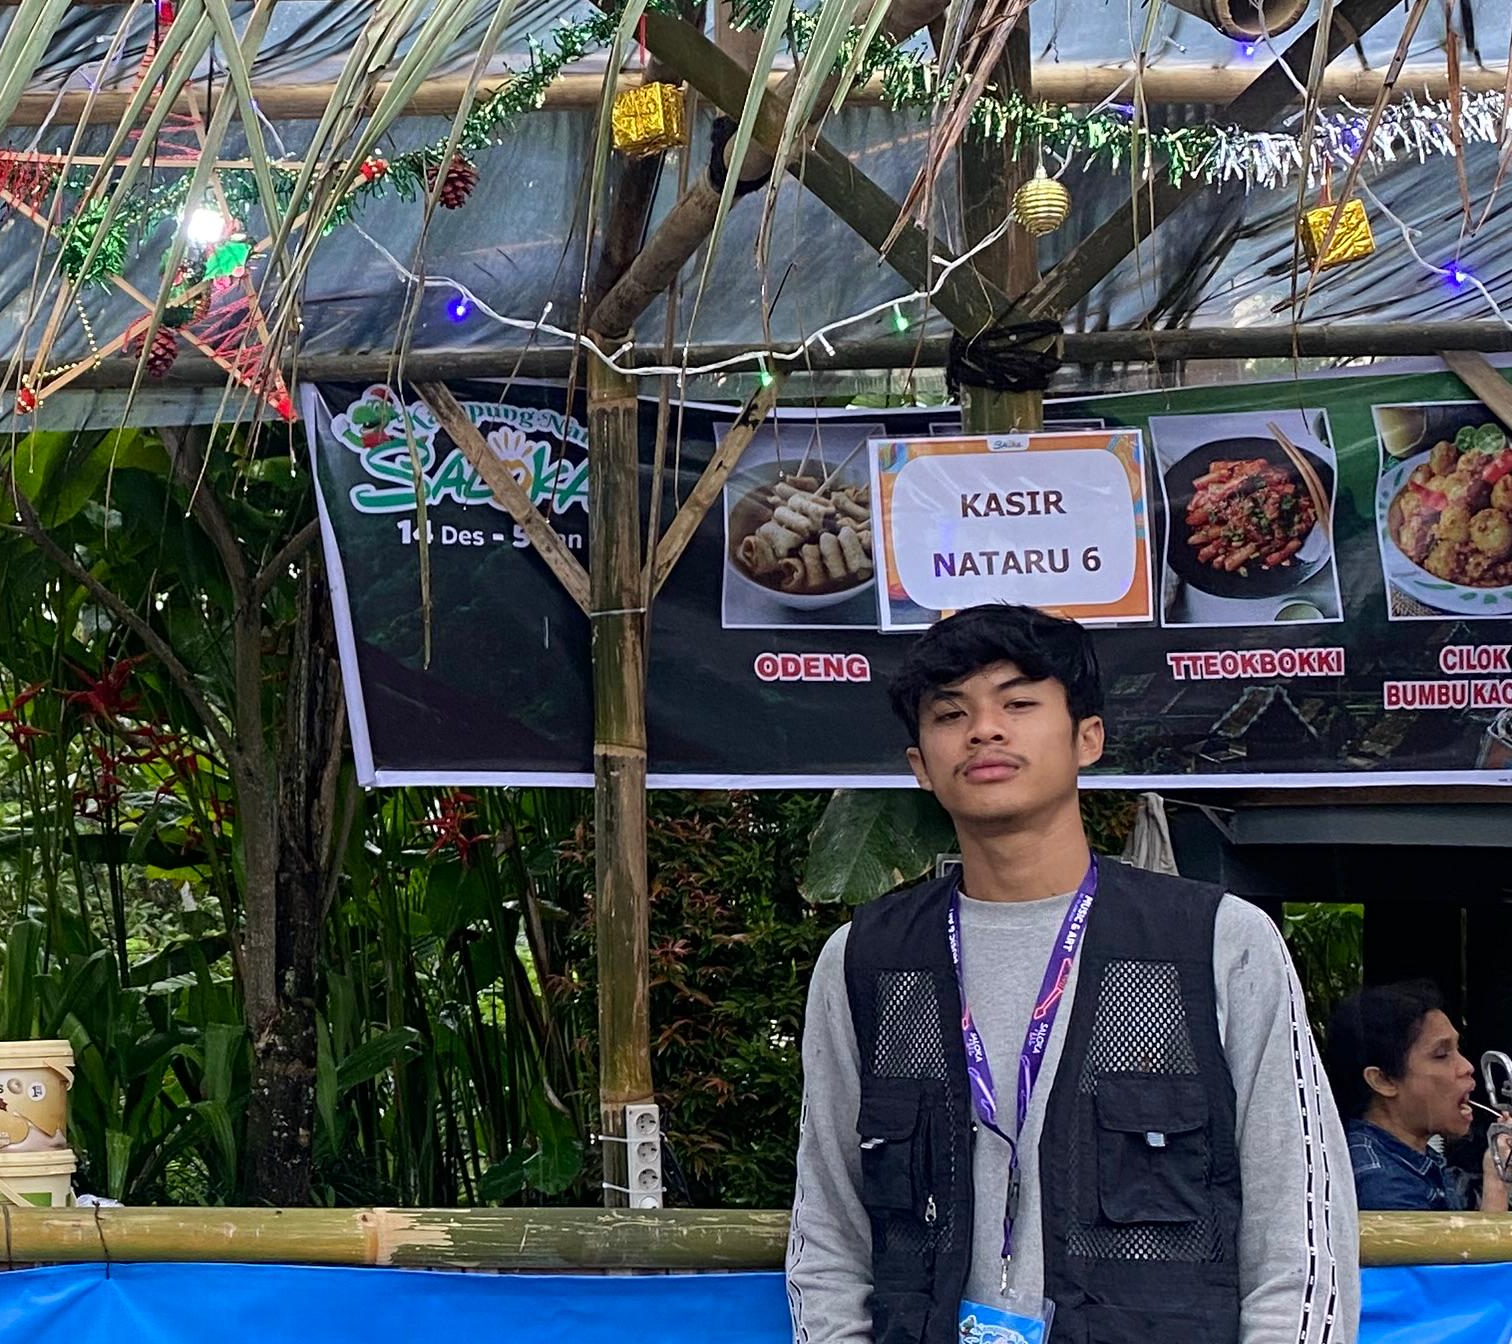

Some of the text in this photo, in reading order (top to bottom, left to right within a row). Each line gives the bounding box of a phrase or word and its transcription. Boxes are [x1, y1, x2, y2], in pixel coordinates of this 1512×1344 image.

[961, 490, 1066, 518] KASIR
[441, 526, 485, 546] Des
[933, 546, 1101, 577] NATARU 6
[756, 654, 870, 681] ODENG
[1168, 649, 1344, 680] TTEOKBOKKI
[1440, 646, 1512, 673] CILOK
[1385, 682, 1468, 708] BUMBU
[1073, 895, 1093, 924] MUSIC
[1062, 931, 1077, 952] ART
